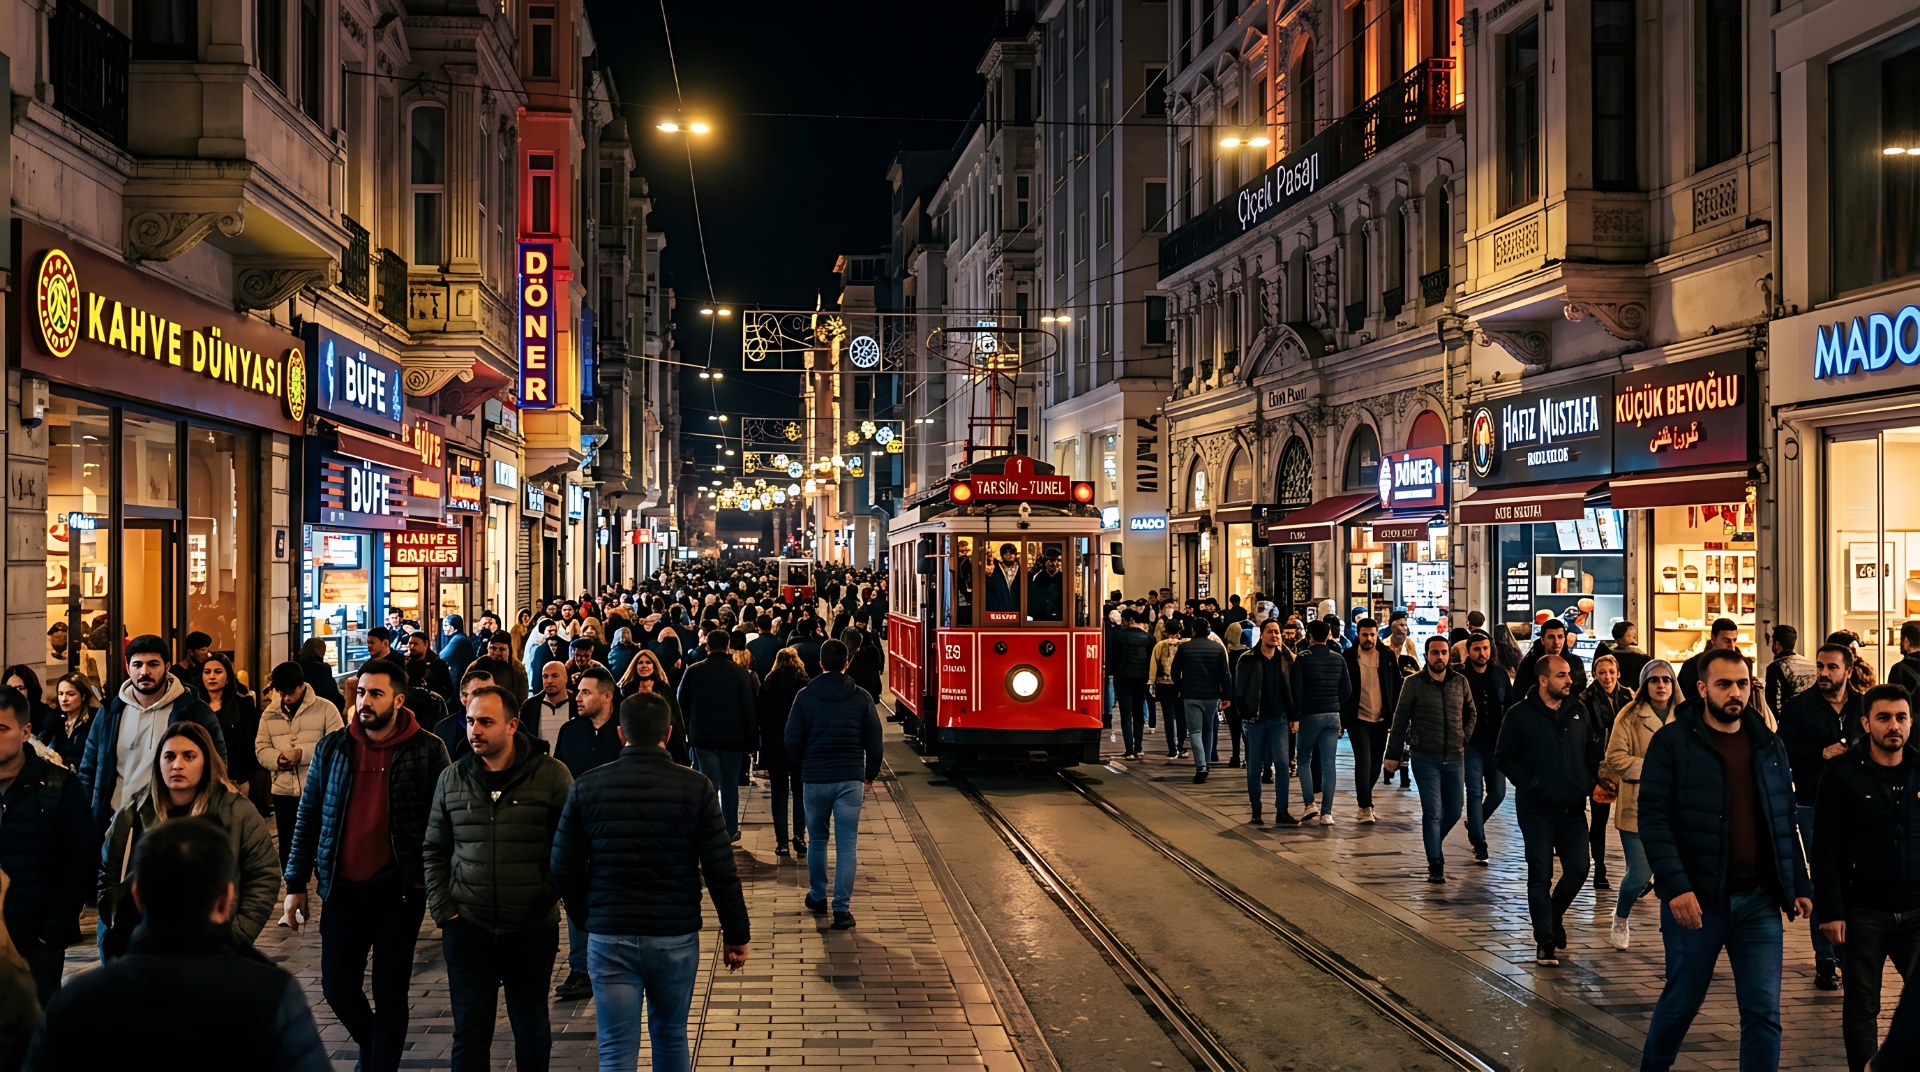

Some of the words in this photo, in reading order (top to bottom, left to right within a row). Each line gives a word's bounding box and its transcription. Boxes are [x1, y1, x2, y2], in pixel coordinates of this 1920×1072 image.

[88, 292, 182, 367] KAHVE
[192, 326, 282, 397] DÜNYASI
[524, 251, 549, 401] DÖNER
[1814, 304, 1920, 380] MADO
[345, 351, 386, 413] BÜFE
[1615, 383, 1663, 428] KÜÇÜK
[1667, 371, 1738, 416] BEYOĞLU
[351, 460, 390, 516] BÜFE
